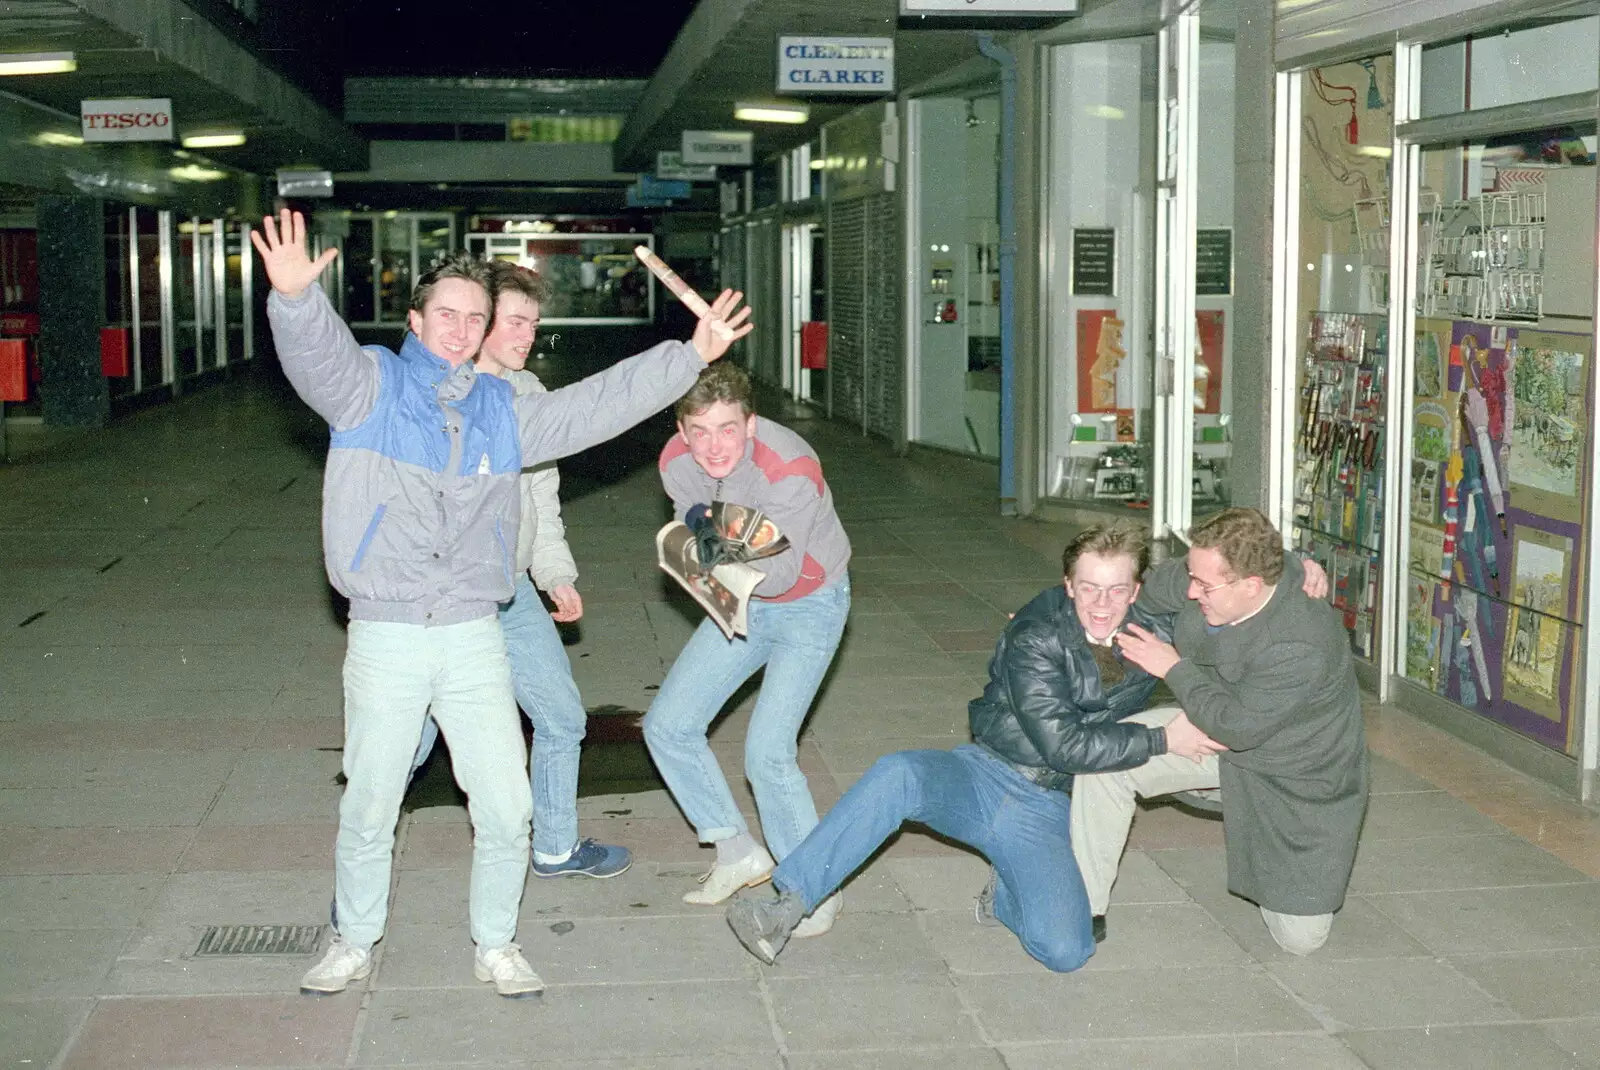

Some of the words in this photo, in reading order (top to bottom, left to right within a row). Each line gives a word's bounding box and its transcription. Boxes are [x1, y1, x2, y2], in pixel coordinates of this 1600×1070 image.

[785, 45, 888, 59] CLEMENT
[788, 70, 885, 84] CLARKE
[84, 112, 169, 129] TESCO
